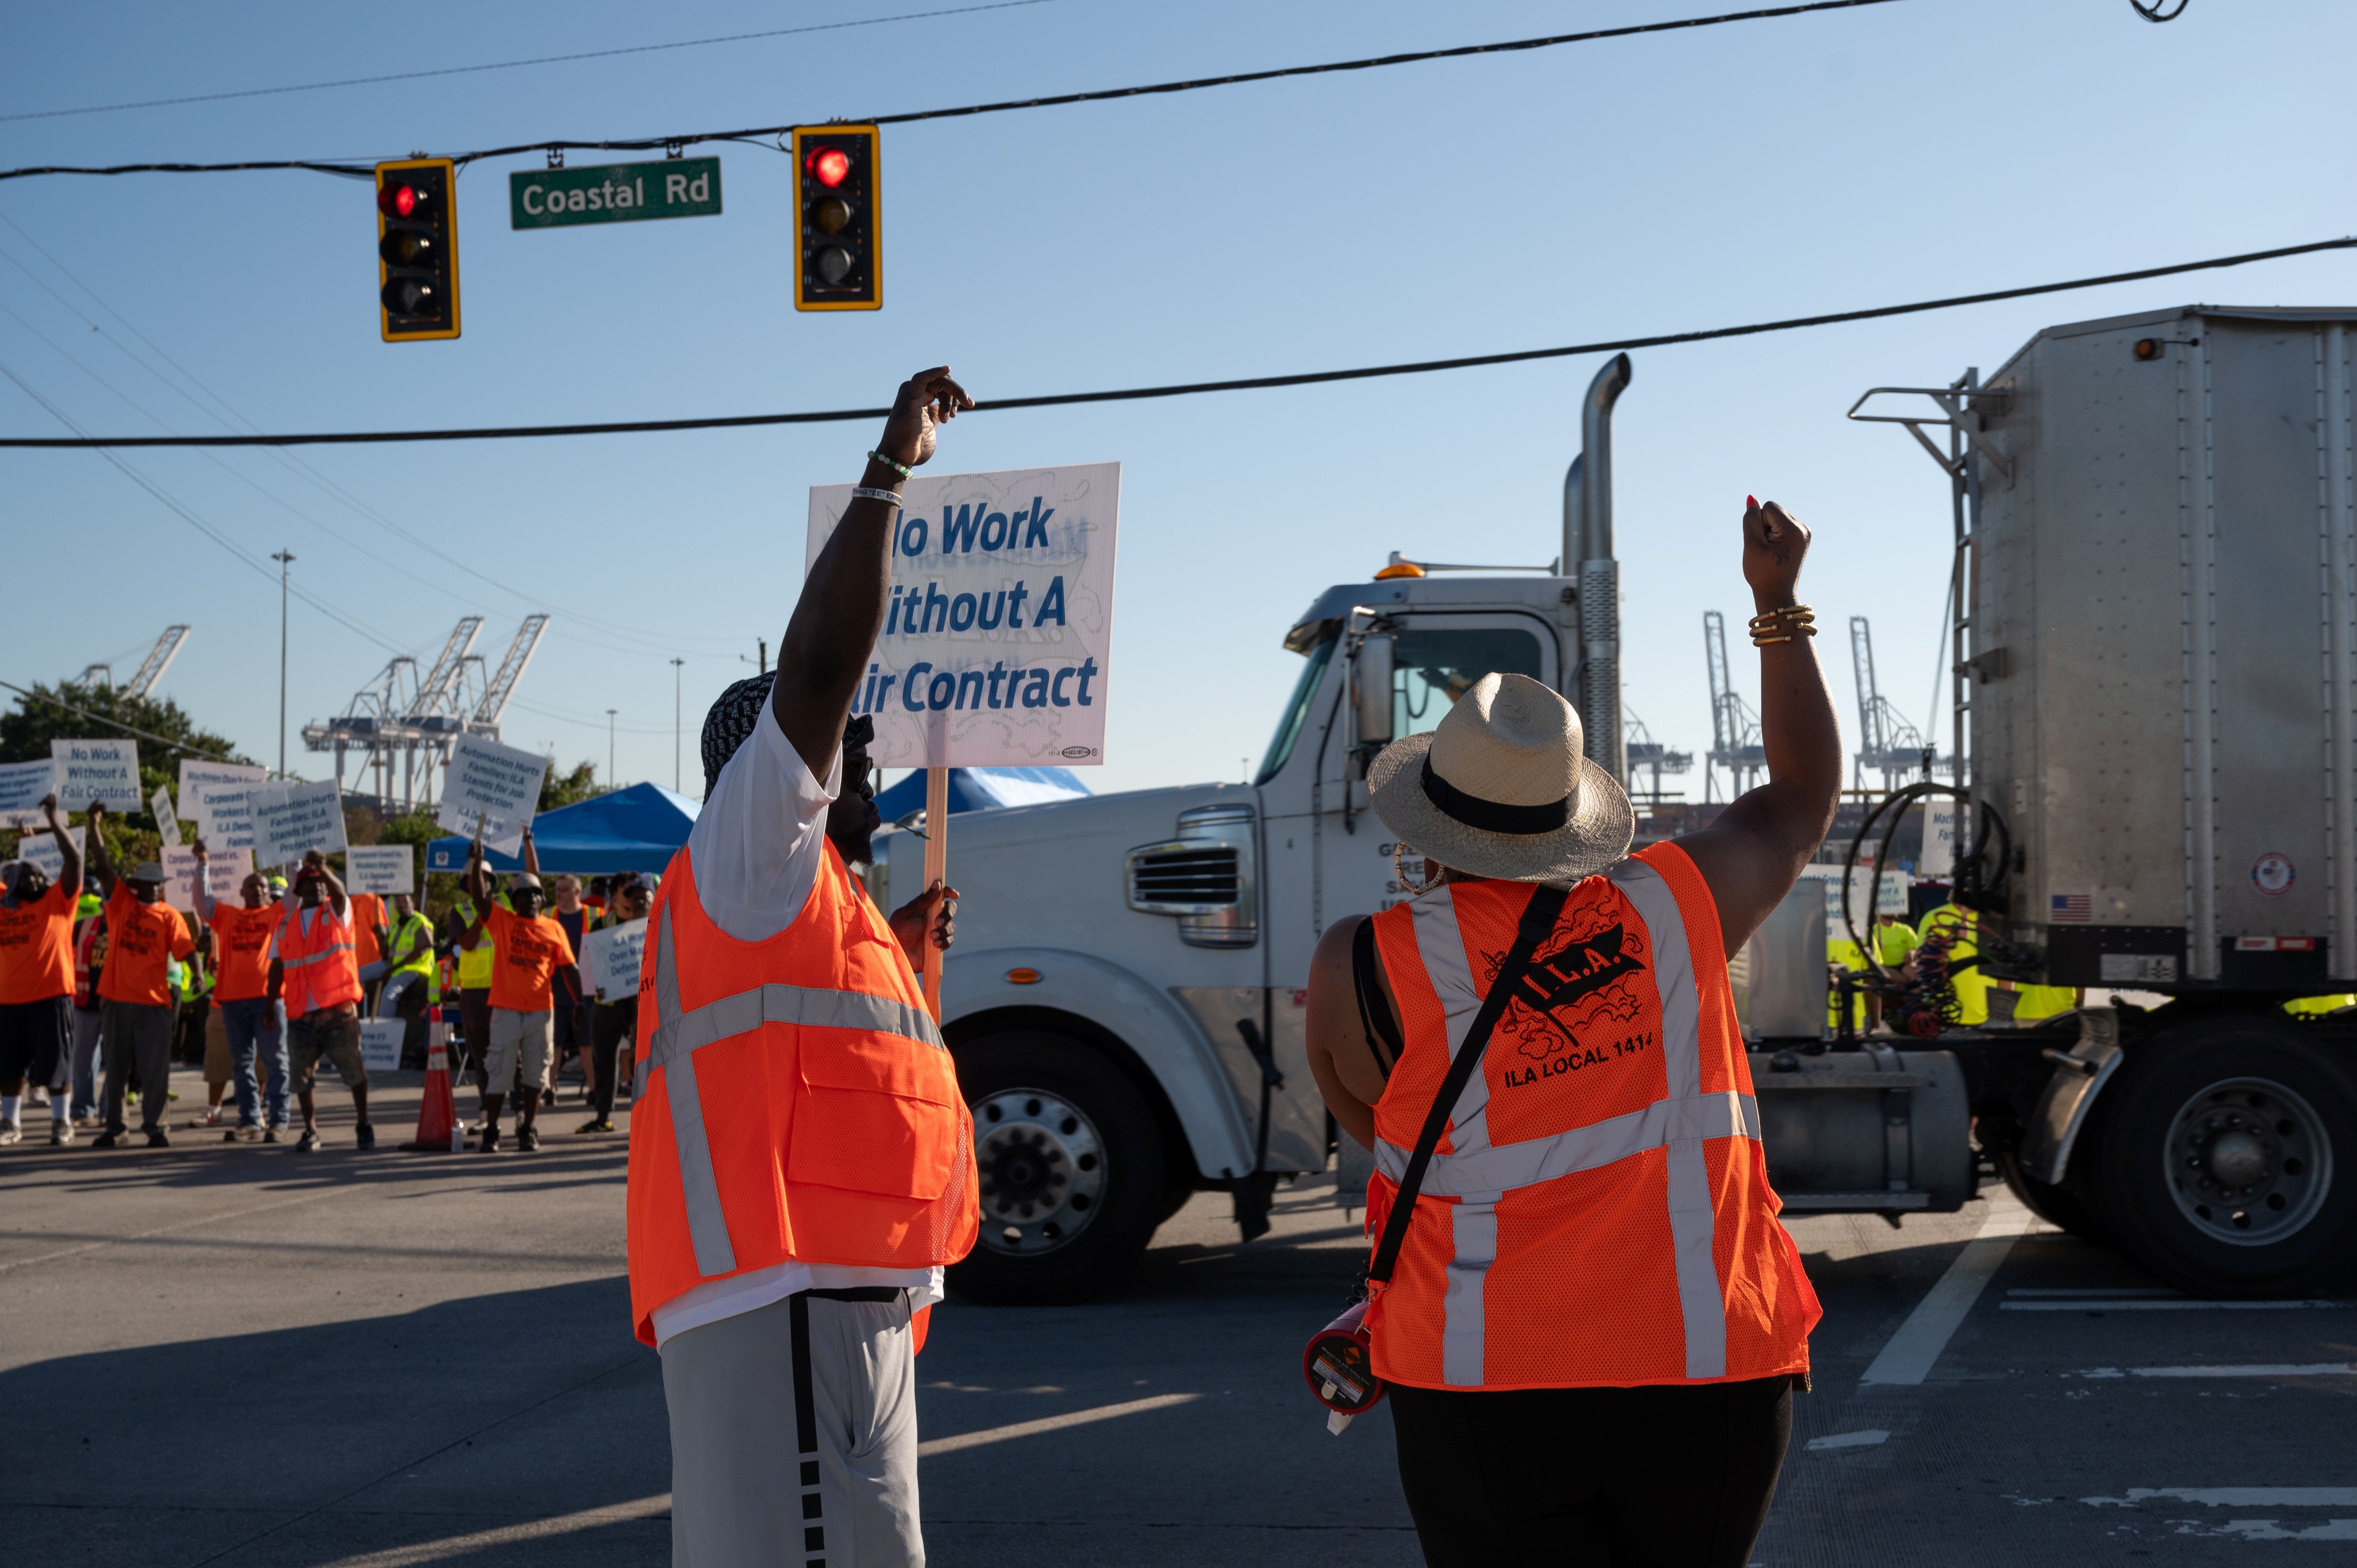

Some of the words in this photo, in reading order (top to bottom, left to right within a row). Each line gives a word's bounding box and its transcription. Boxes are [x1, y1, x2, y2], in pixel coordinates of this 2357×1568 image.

[523, 177, 643, 215] Coastal
[666, 172, 709, 205] Rd
[943, 496, 1055, 554] Work
[886, 580, 1029, 635] ithout
[1033, 576, 1066, 627] A
[850, 663, 896, 714] ir
[902, 657, 1098, 712] Contract
[72, 747, 88, 761] No
[91, 747, 120, 760] Work
[459, 745, 514, 768] Automation
[515, 759, 540, 777] Hurts
[68, 766, 116, 779] Without
[120, 767, 128, 779] A
[467, 761, 508, 778] Families:
[510, 774, 525, 786] ILA
[61, 785, 84, 797] Fair
[86, 785, 138, 798] Contract
[461, 772, 494, 789] Stands
[494, 782, 508, 794] for
[509, 789, 525, 799] Job
[257, 798, 310, 817] Automation
[312, 793, 336, 805] Hurts
[466, 788, 514, 809] Protection
[312, 807, 326, 819] ILA
[269, 828, 301, 843] Stands
[302, 824, 315, 836] for
[317, 821, 332, 831] Job
[280, 836, 326, 852] Protection
[1504, 1066, 1538, 1088] ILA
[1542, 1046, 1609, 1078] LOCAL
